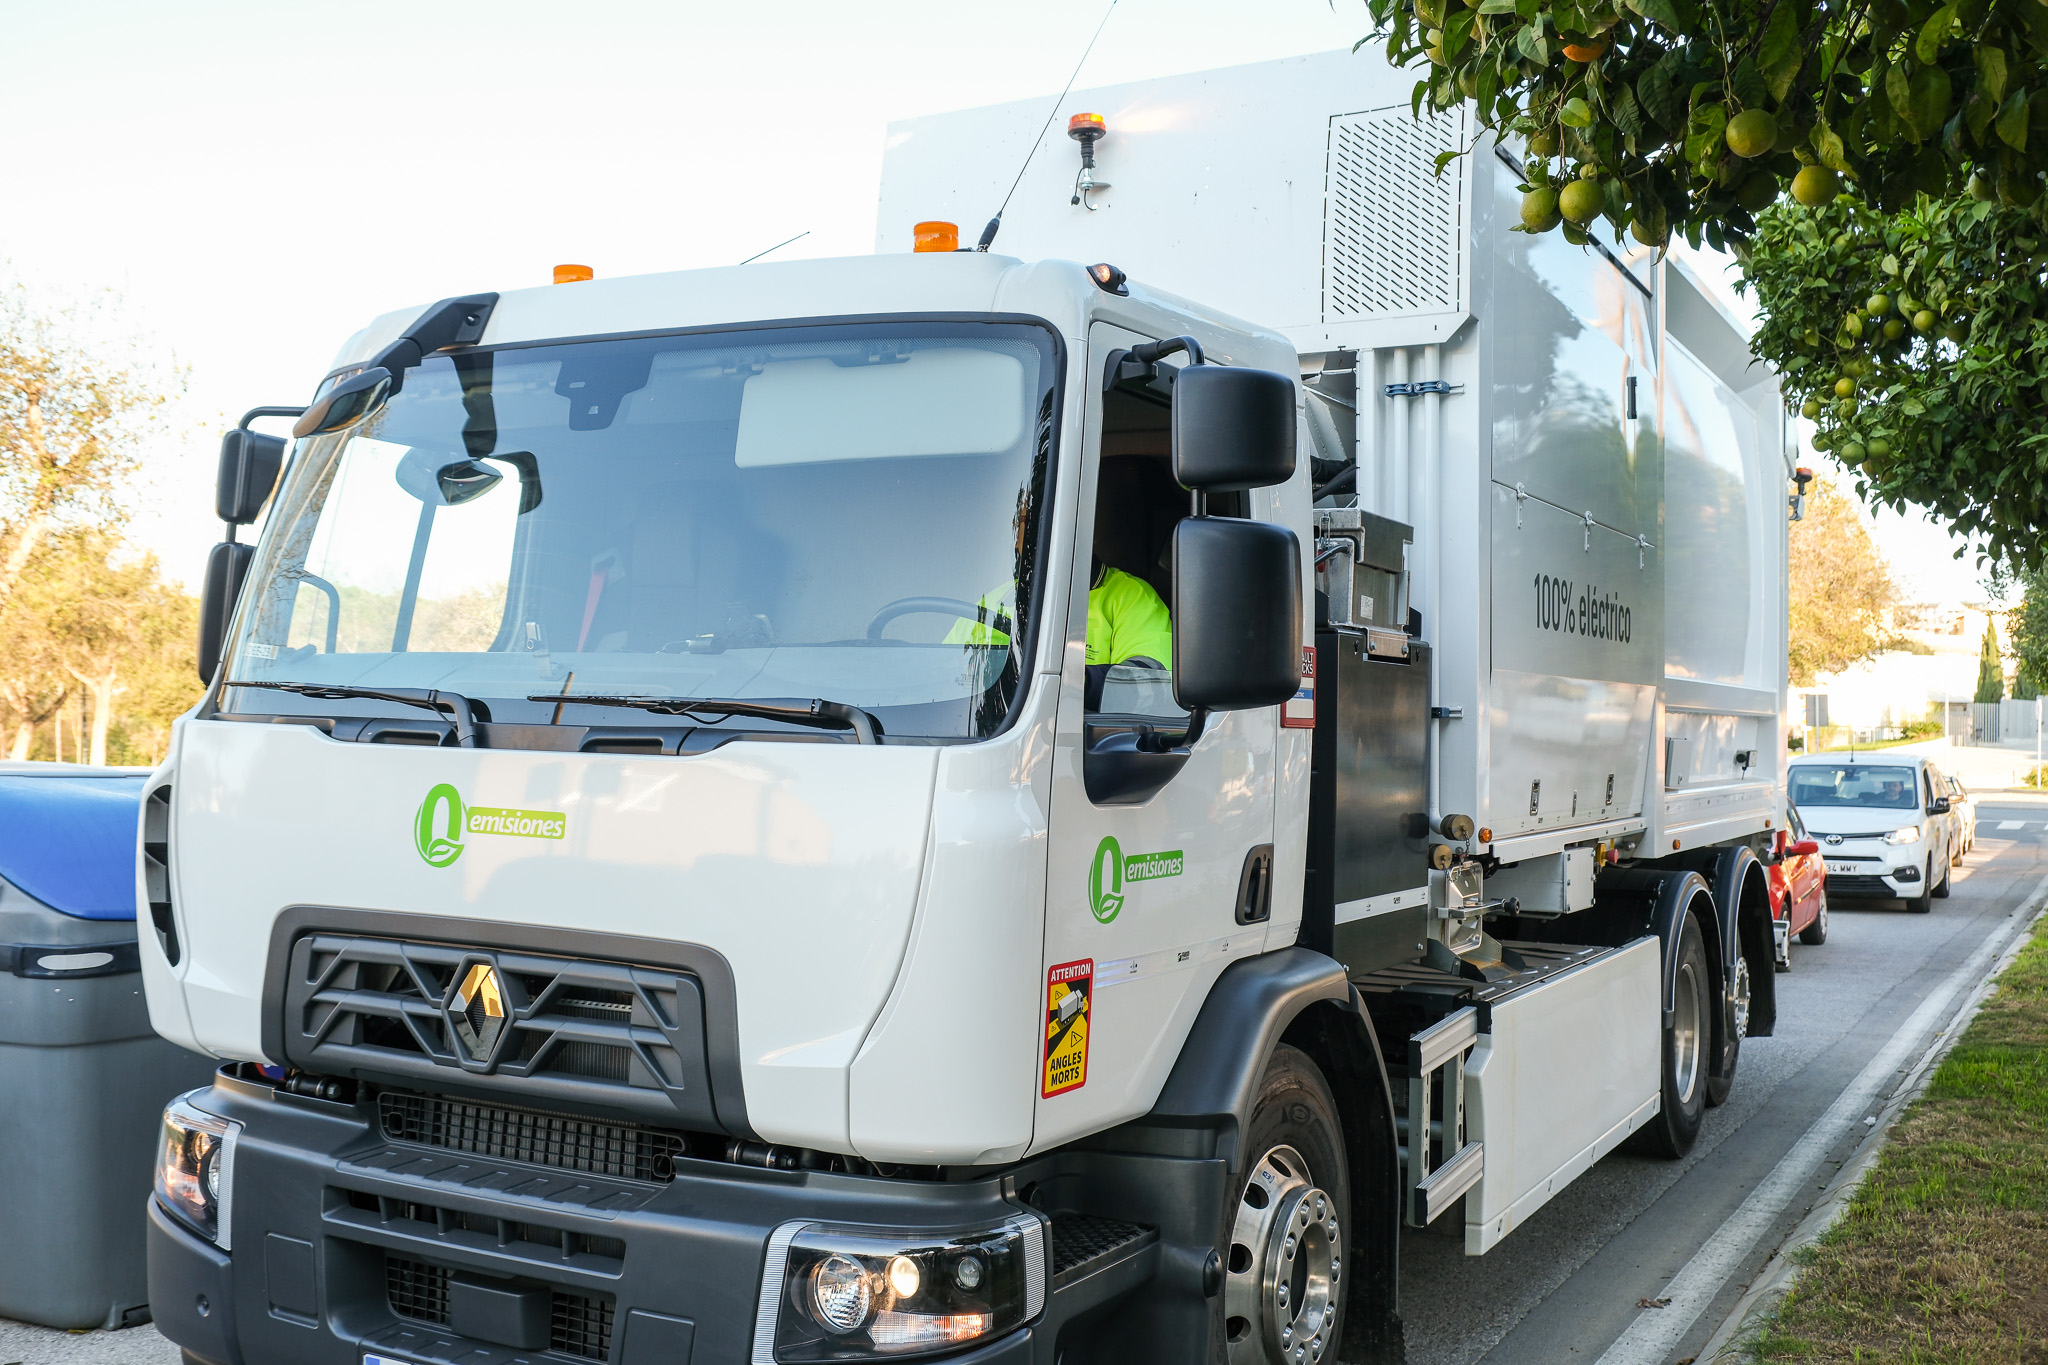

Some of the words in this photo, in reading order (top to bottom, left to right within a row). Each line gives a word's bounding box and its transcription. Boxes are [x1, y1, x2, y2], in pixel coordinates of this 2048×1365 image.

[1534, 573, 1576, 634] 100%
[1580, 584, 1631, 643] eléctrico
[1301, 652, 1314, 663] AULT
[1301, 663, 1314, 675] CKS
[470, 810, 563, 837] emisiones
[1127, 854, 1182, 880] emisiones
[1050, 962, 1091, 982] ATTENTION
[1049, 1051, 1082, 1072] ANGLES
[1050, 1066, 1080, 1086] MORTS
